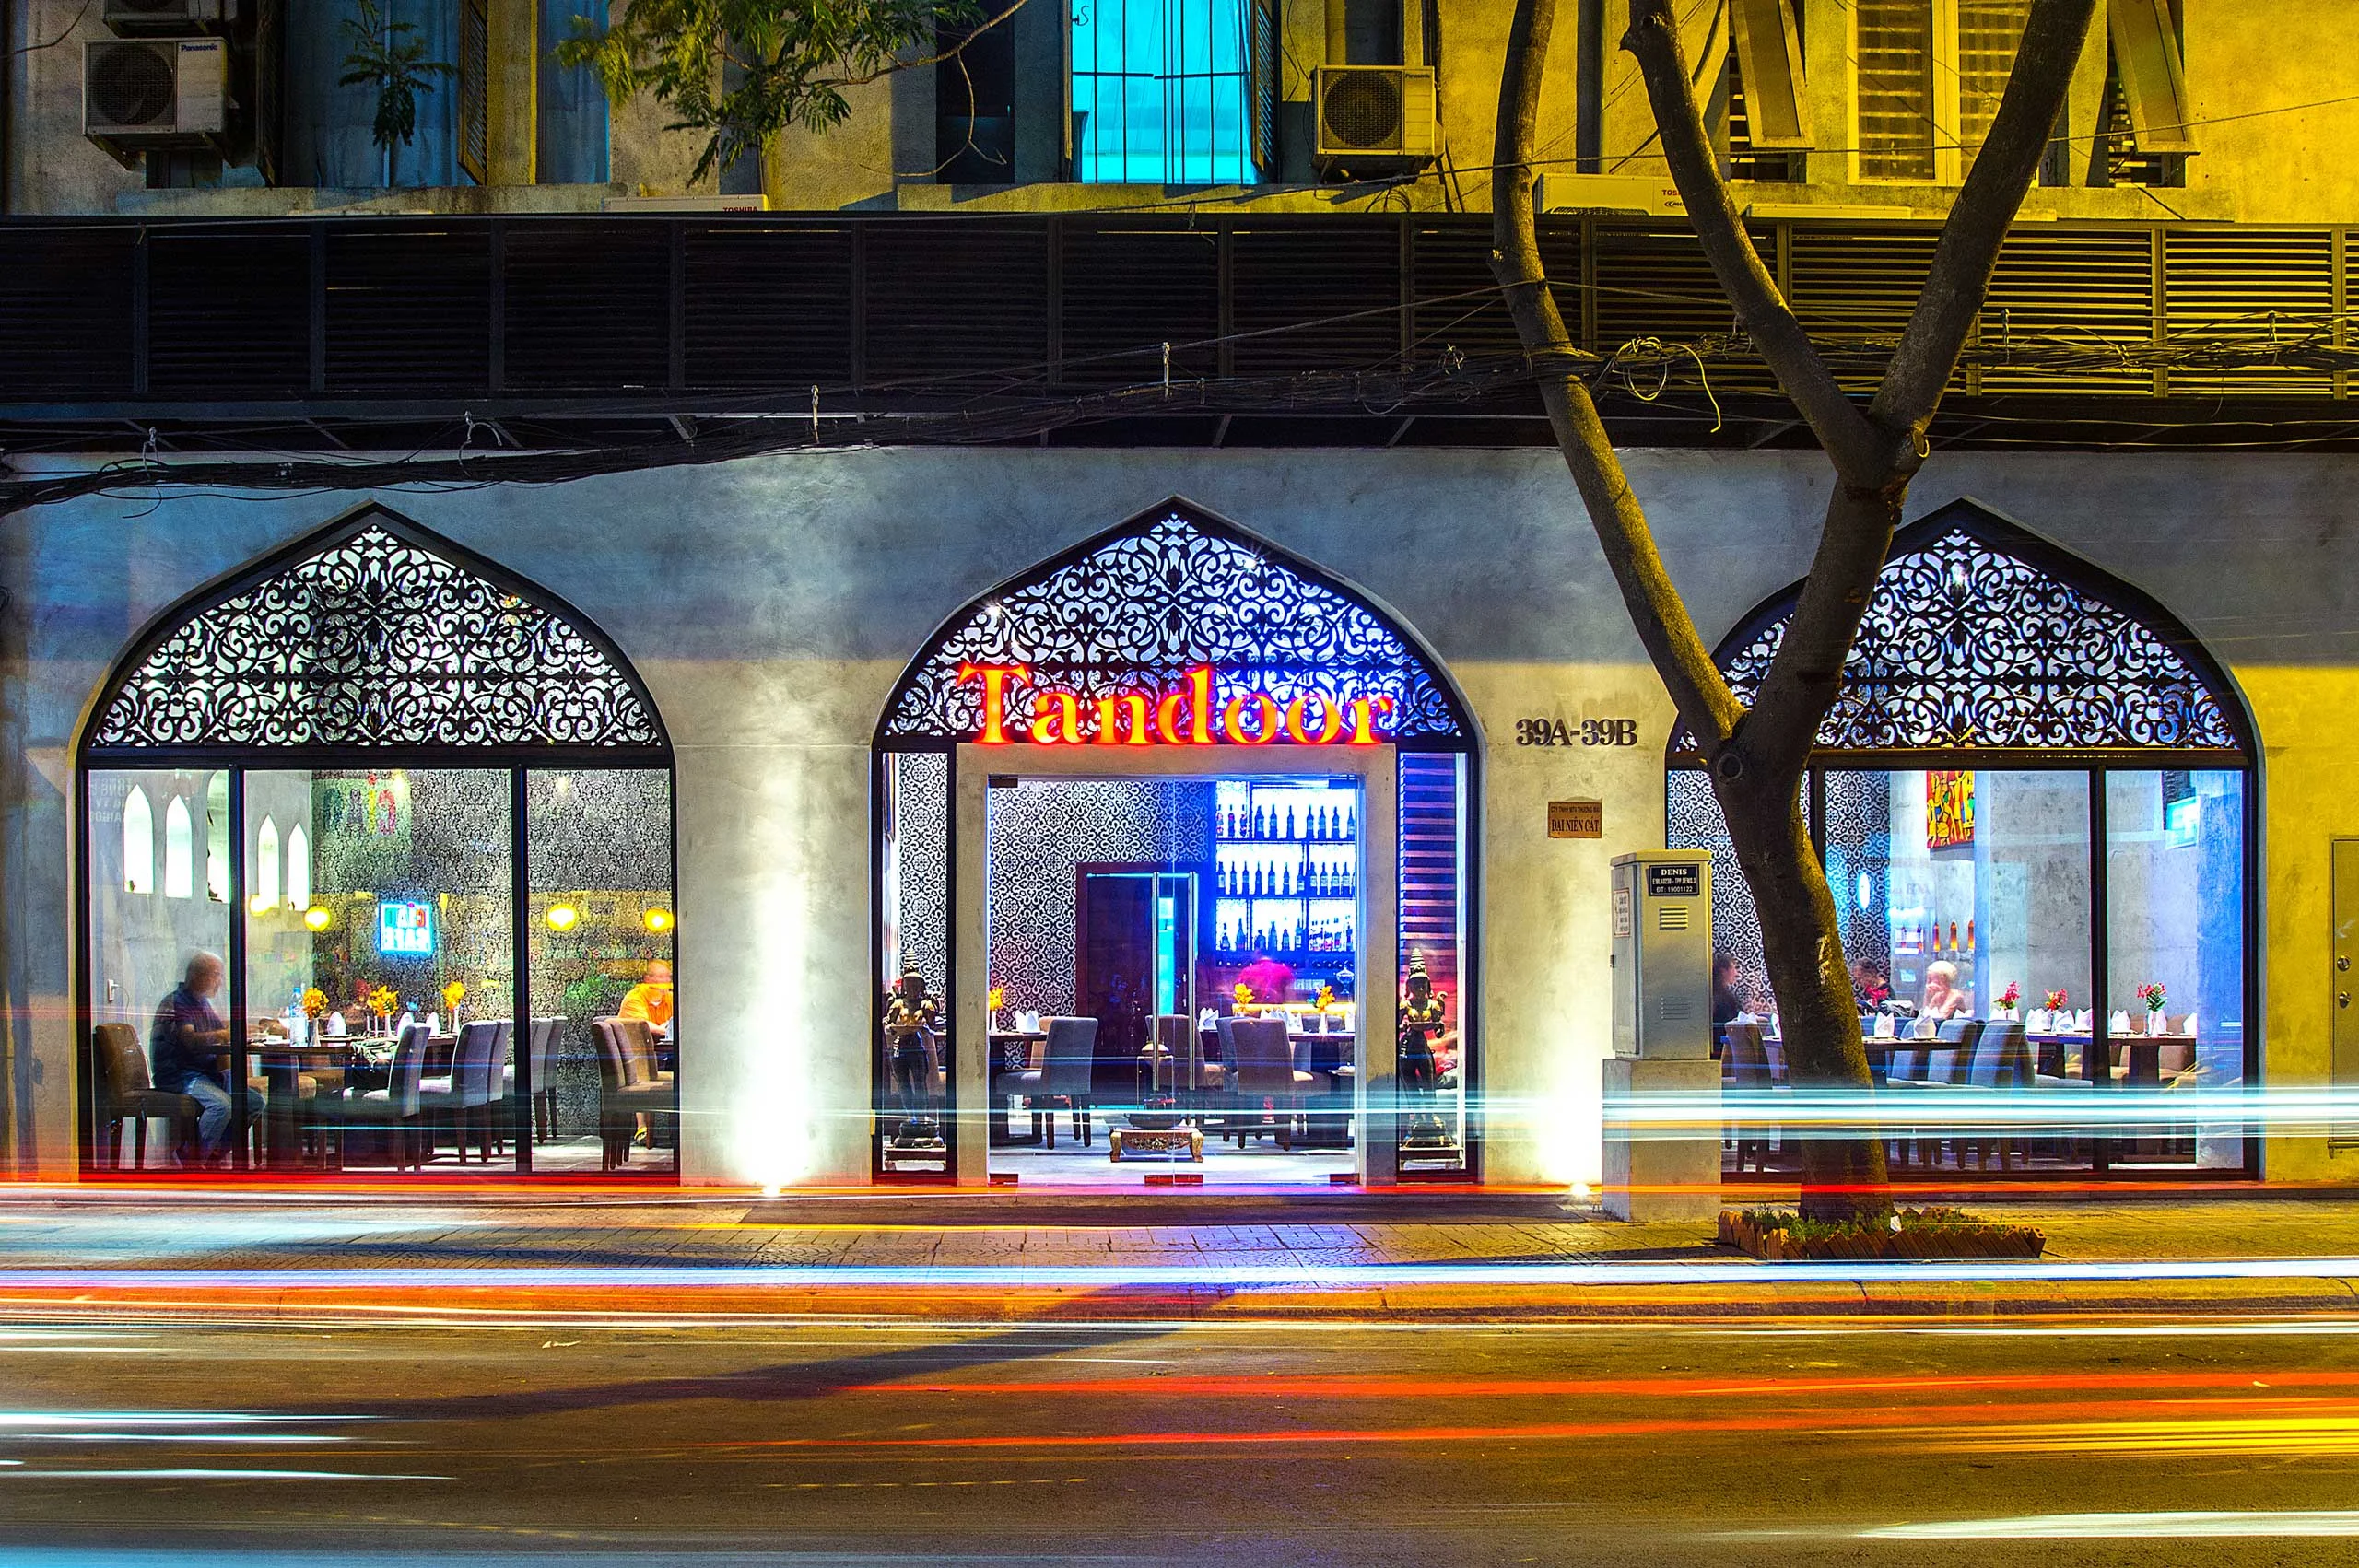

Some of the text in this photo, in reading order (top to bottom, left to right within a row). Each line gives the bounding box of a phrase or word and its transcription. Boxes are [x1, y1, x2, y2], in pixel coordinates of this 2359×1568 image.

[181, 43, 217, 52] Panasonic
[957, 662, 1394, 745] Tandoor
[1515, 718, 1638, 747] 39A-39B
[1661, 868, 1688, 876] DENIS
